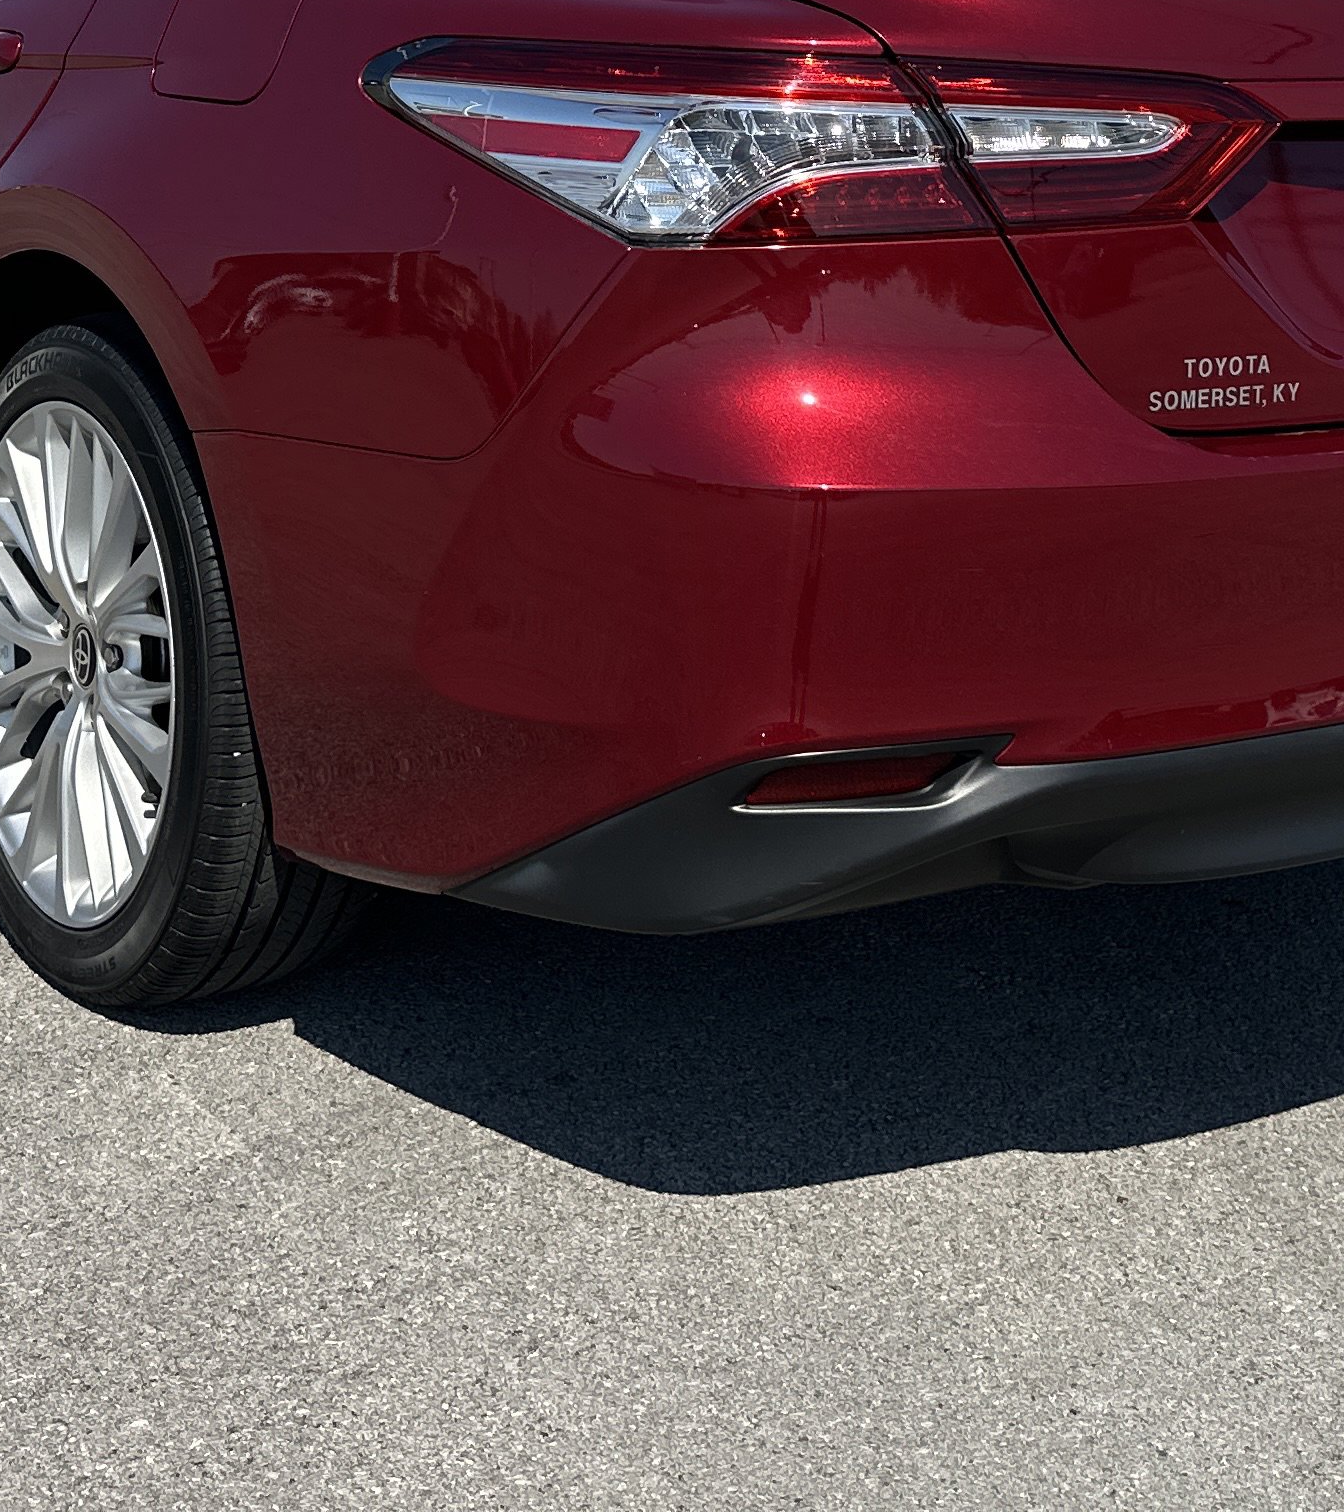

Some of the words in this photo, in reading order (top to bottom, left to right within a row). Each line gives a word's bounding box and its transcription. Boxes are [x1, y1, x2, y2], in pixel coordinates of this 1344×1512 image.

[1184, 354, 1271, 378] TOYOTA
[1149, 384, 1267, 412] SOMERSET,
[1273, 382, 1300, 403] KY
